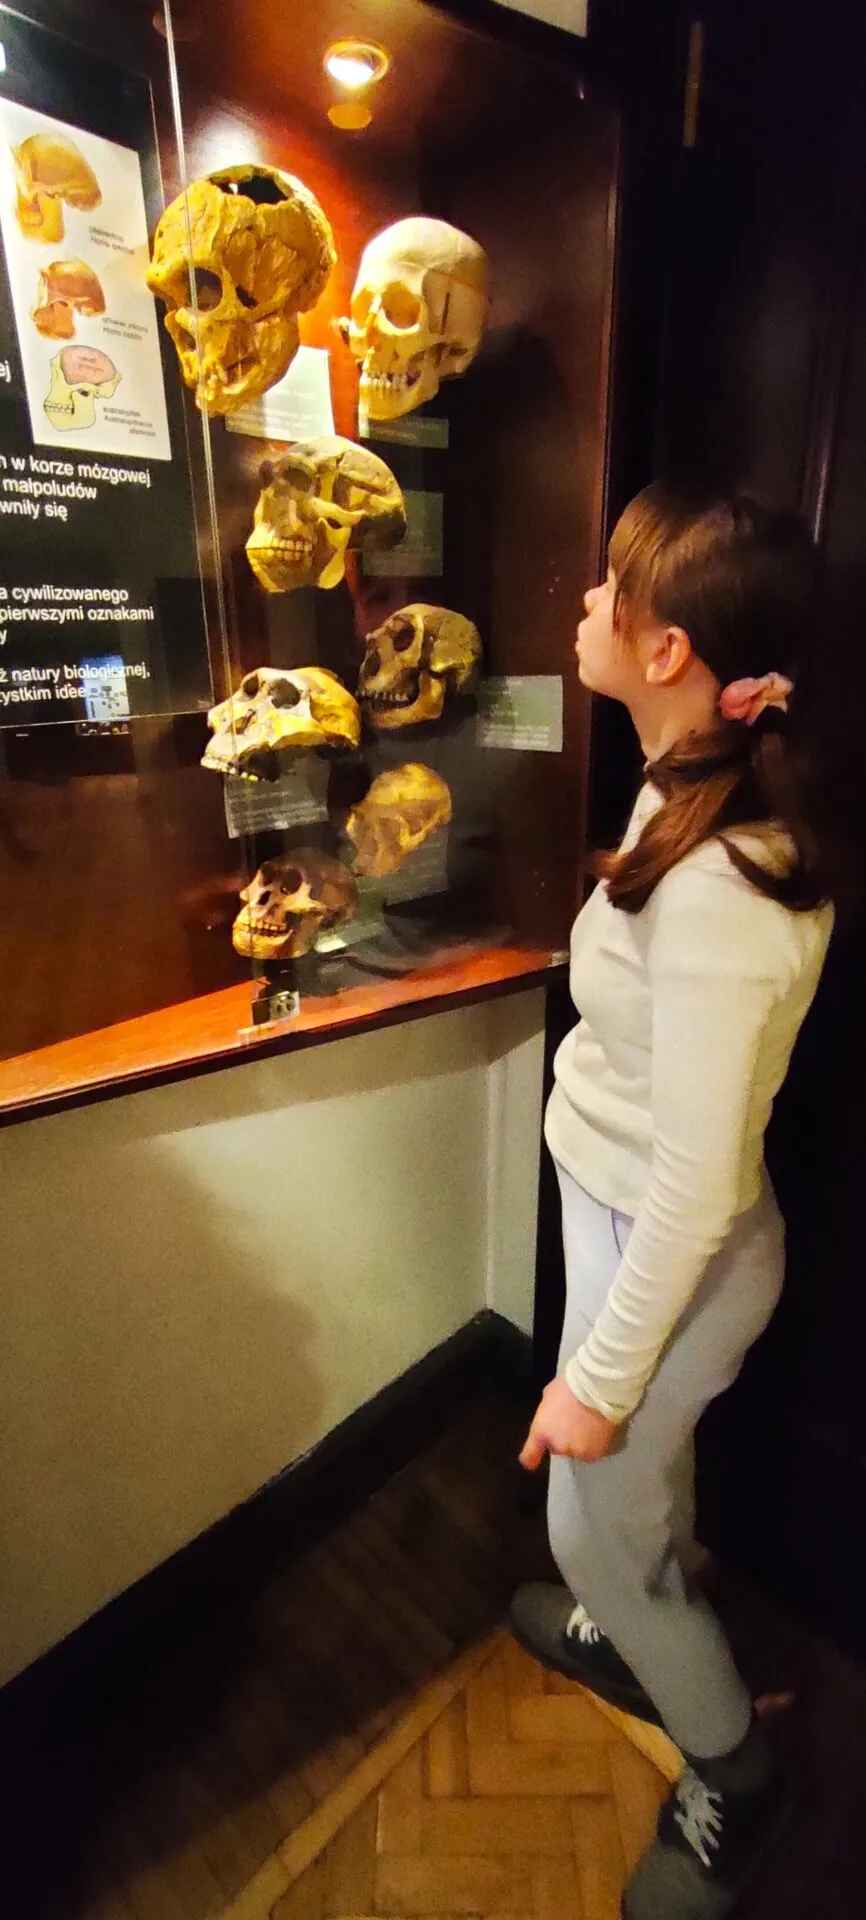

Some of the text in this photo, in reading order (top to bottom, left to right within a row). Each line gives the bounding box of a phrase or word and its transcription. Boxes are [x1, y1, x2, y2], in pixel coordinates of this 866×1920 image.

[10, 456, 26, 471] w
[29, 454, 74, 476] korze
[77, 463, 151, 489] mózgowej
[44, 501, 68, 521] się
[12, 584, 129, 604] cywilizowanego
[0, 605, 154, 624] pierwszymi oznakami
[11, 666, 60, 684] natury
